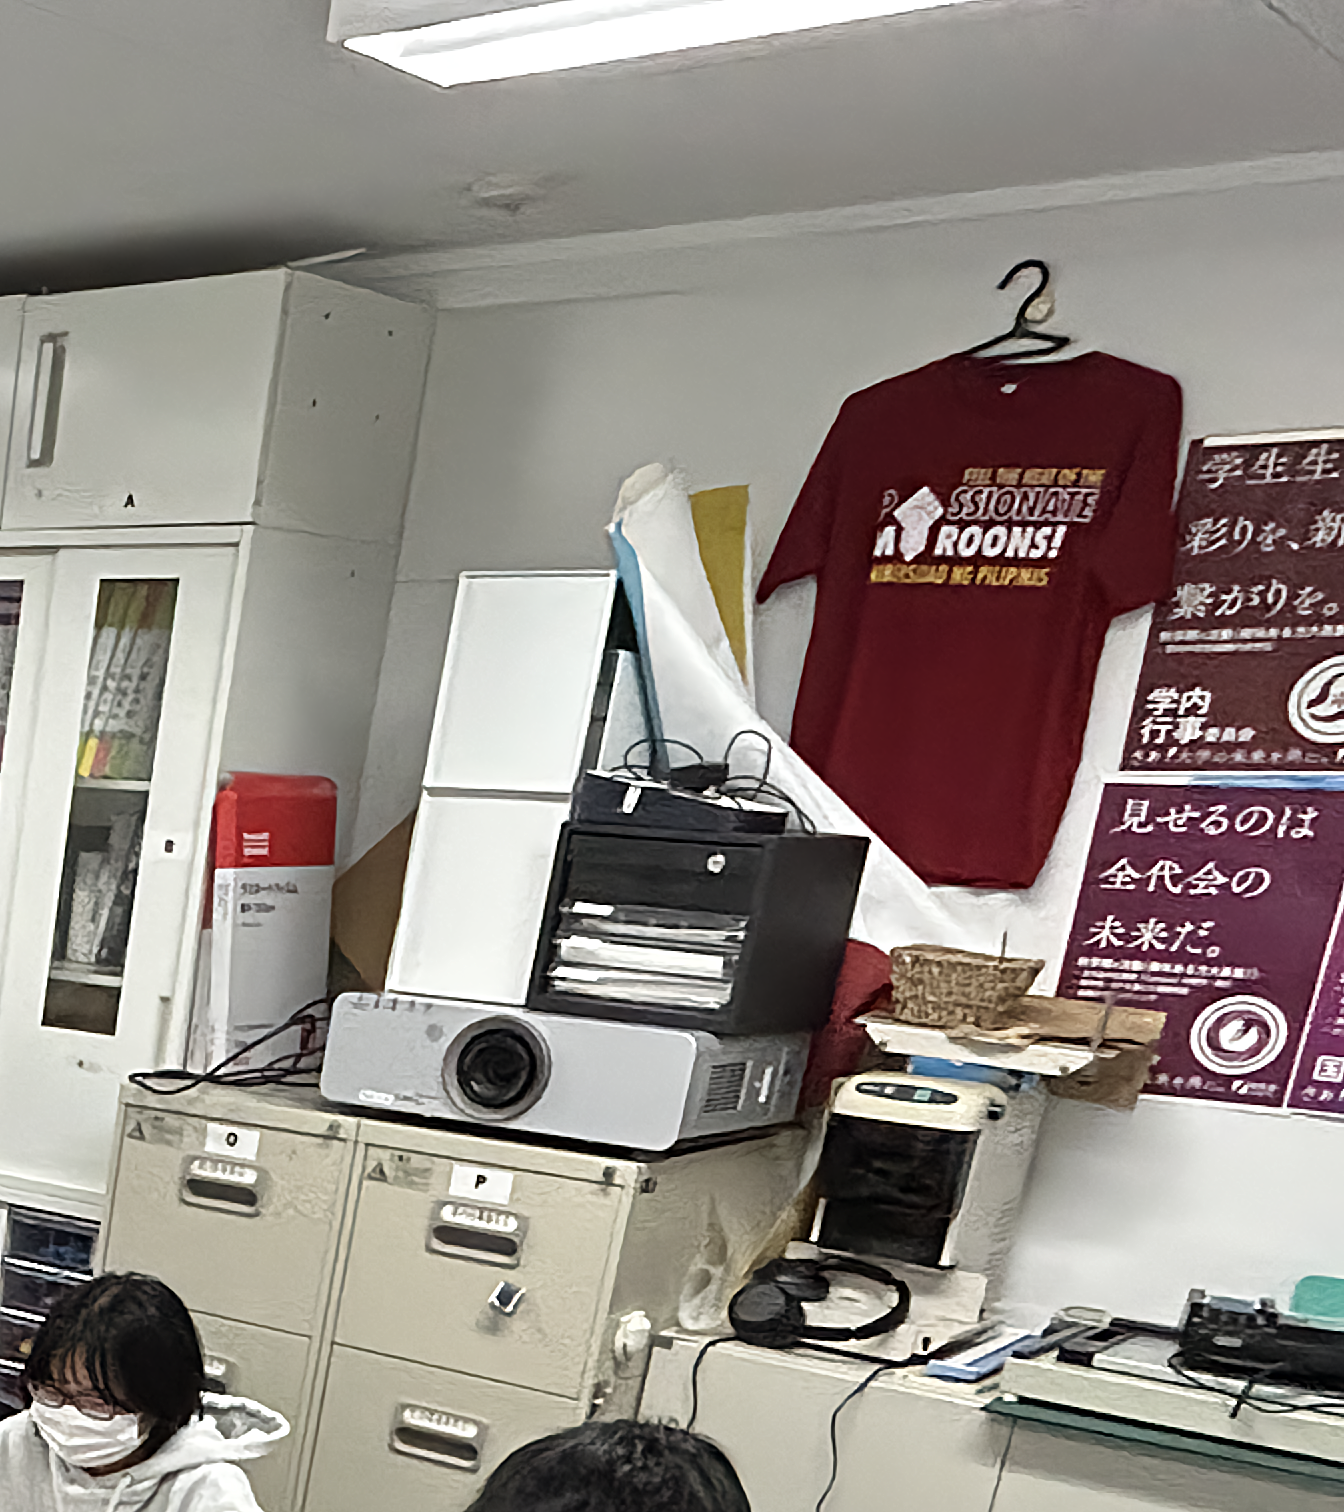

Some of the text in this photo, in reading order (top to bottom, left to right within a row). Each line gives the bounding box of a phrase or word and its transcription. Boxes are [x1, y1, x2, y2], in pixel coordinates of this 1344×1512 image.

[123, 493, 135, 508] A
[1145, 686, 1212, 716] 学内
[1109, 798, 1319, 839] 見せるのは
[1098, 856, 1271, 898] 全代会の
[1083, 914, 1221, 957] 未来だ。
[474, 1174, 487, 1189] P
